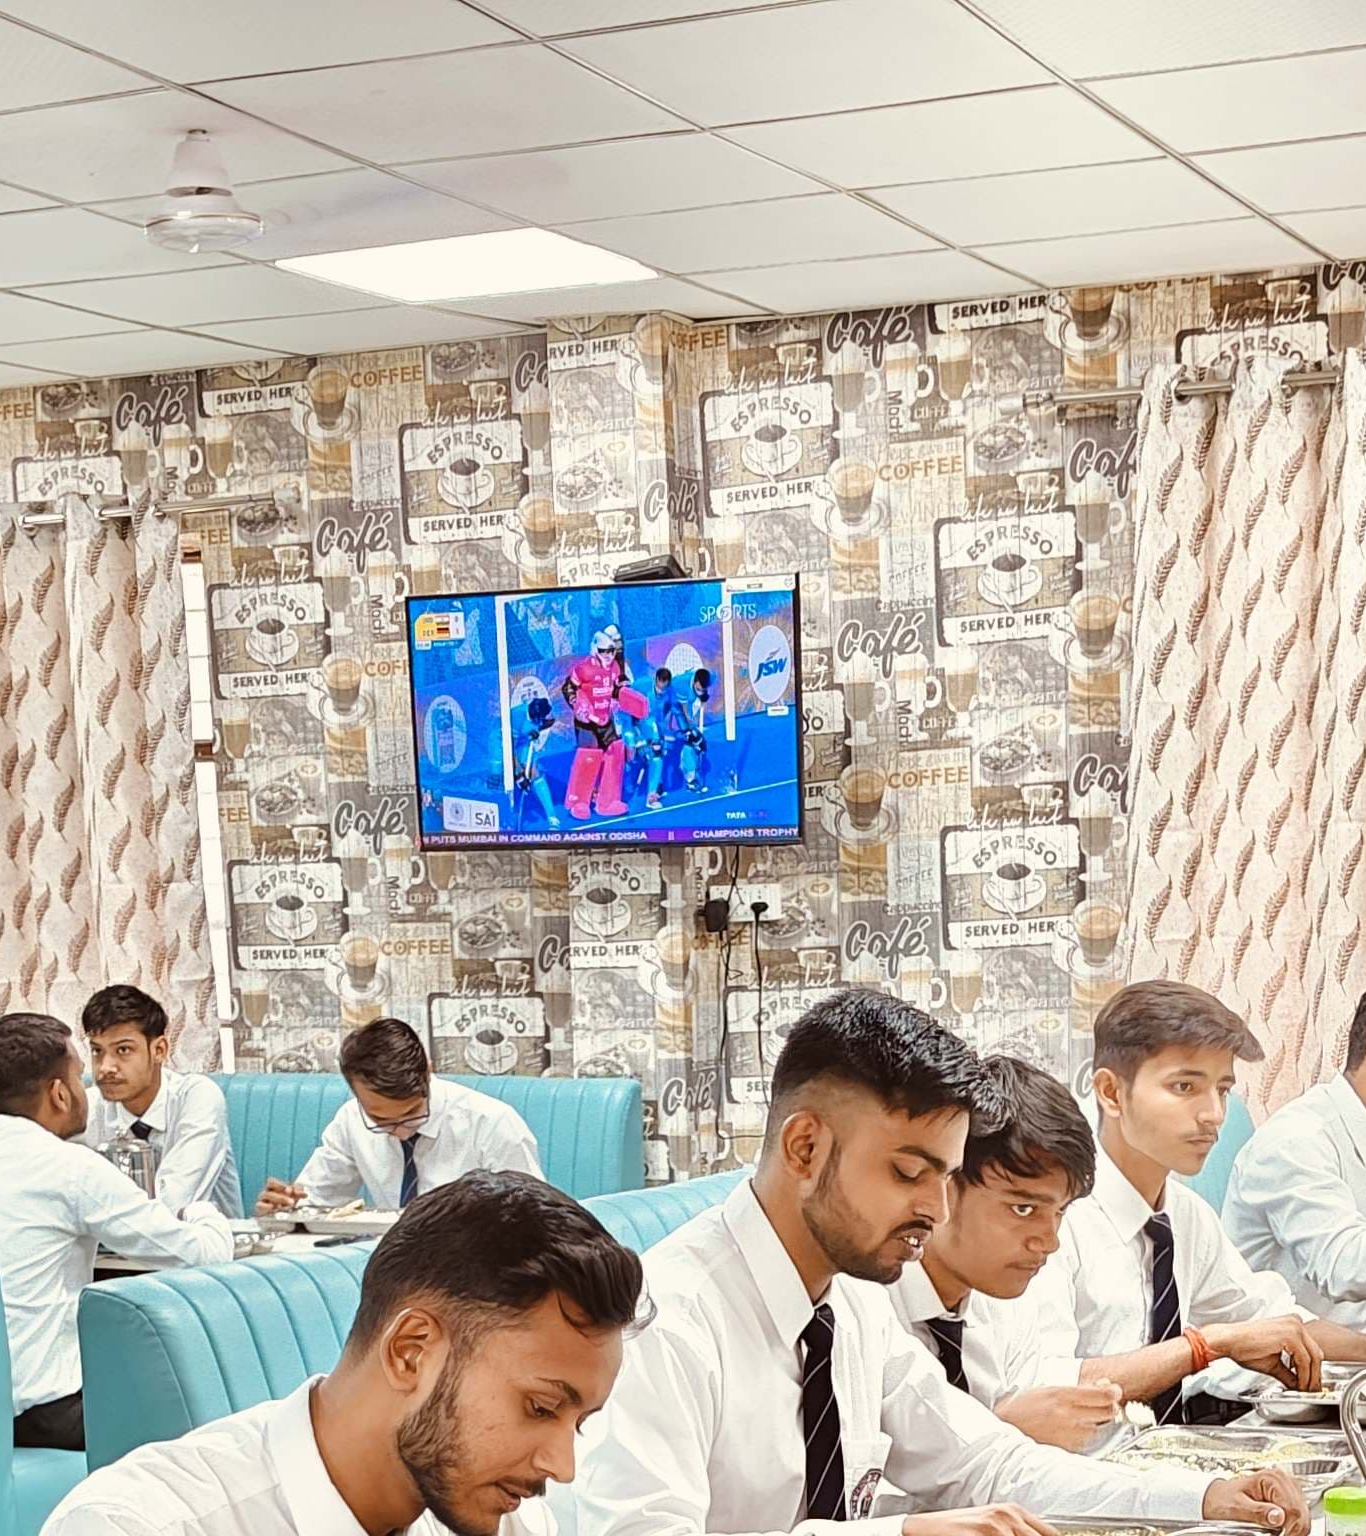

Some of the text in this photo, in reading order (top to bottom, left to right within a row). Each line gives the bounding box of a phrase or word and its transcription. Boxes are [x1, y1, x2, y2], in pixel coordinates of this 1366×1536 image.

[952, 294, 1052, 320] SERVED HER
[592, 339, 621, 354] HER
[350, 365, 423, 389] COFFEE
[269, 386, 295, 400] HER
[116, 386, 187, 448] Café
[731, 396, 812, 432] ESPRESSO
[427, 430, 503, 465] ESPRESSO
[879, 455, 963, 481] COFFEE
[1070, 431, 1136, 498] Caf
[38, 467, 105, 497] ESPRESSO
[727, 480, 816, 504] SERVED HER
[479, 514, 507, 527] HER
[316, 511, 393, 574] Café
[966, 523, 1053, 561] ESPRESSO
[235, 592, 306, 624] ESPRESSO
[960, 613, 1056, 634] SERVED HER
[837, 612, 926, 680] Café
[285, 672, 311, 684] HER
[753, 657, 788, 684] JSW
[888, 766, 970, 789] COFFEE
[1073, 752, 1131, 814] Caf
[334, 798, 408, 856] Café
[726, 811, 747, 819] TATA
[431, 836, 456, 845] PUTS
[458, 835, 497, 844] MUMBAI
[498, 834, 509, 843] IN
[510, 833, 561, 843] COMMAND
[563, 832, 607, 842] AGAINST
[608, 831, 648, 841] ODISHA
[692, 827, 800, 839] CHAMPIONS TROPHY
[972, 834, 1058, 869] ESPRESSO
[254, 869, 325, 900] ESPRESSO
[964, 919, 1059, 938] SERVED HER
[304, 948, 329, 959] HER
[382, 939, 450, 956] COFFEE
[616, 943, 643, 957] HER
[844, 916, 931, 978] Café
[454, 1003, 527, 1034] ESPRESSO
